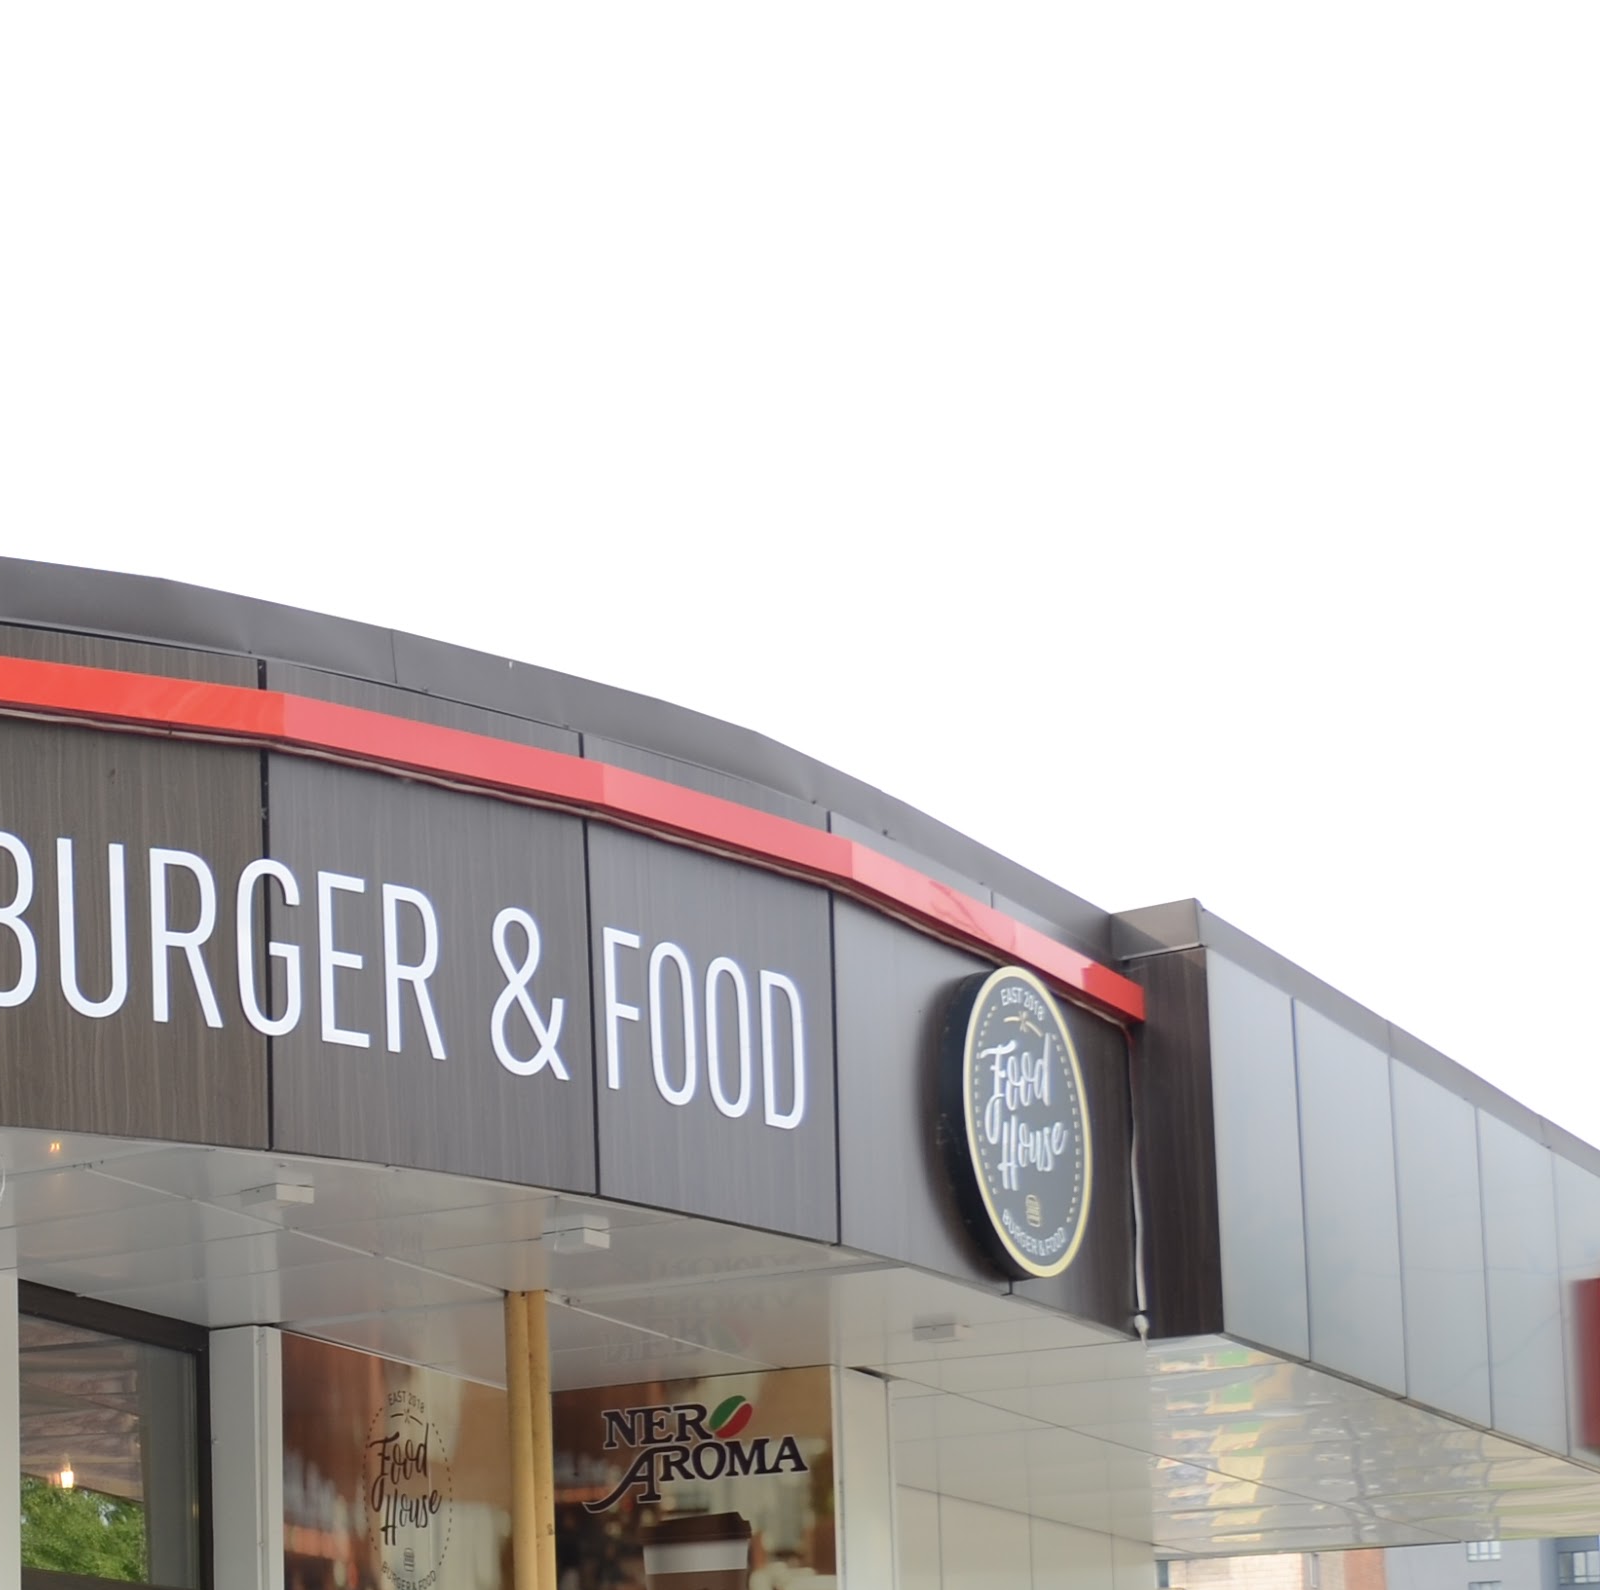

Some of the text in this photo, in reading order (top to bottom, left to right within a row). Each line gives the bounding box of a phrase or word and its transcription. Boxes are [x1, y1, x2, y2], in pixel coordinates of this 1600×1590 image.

[490, 907, 570, 1081] &
[602, 926, 803, 1130] FOOD
[1001, 987, 1023, 1008] EAST
[980, 1032, 1051, 1145] Food
[997, 1115, 1068, 1191] House
[388, 1390, 406, 1406] EAST
[369, 1422, 429, 1512] Food
[582, 1435, 809, 1512] AROMA
[380, 1488, 442, 1546] House
